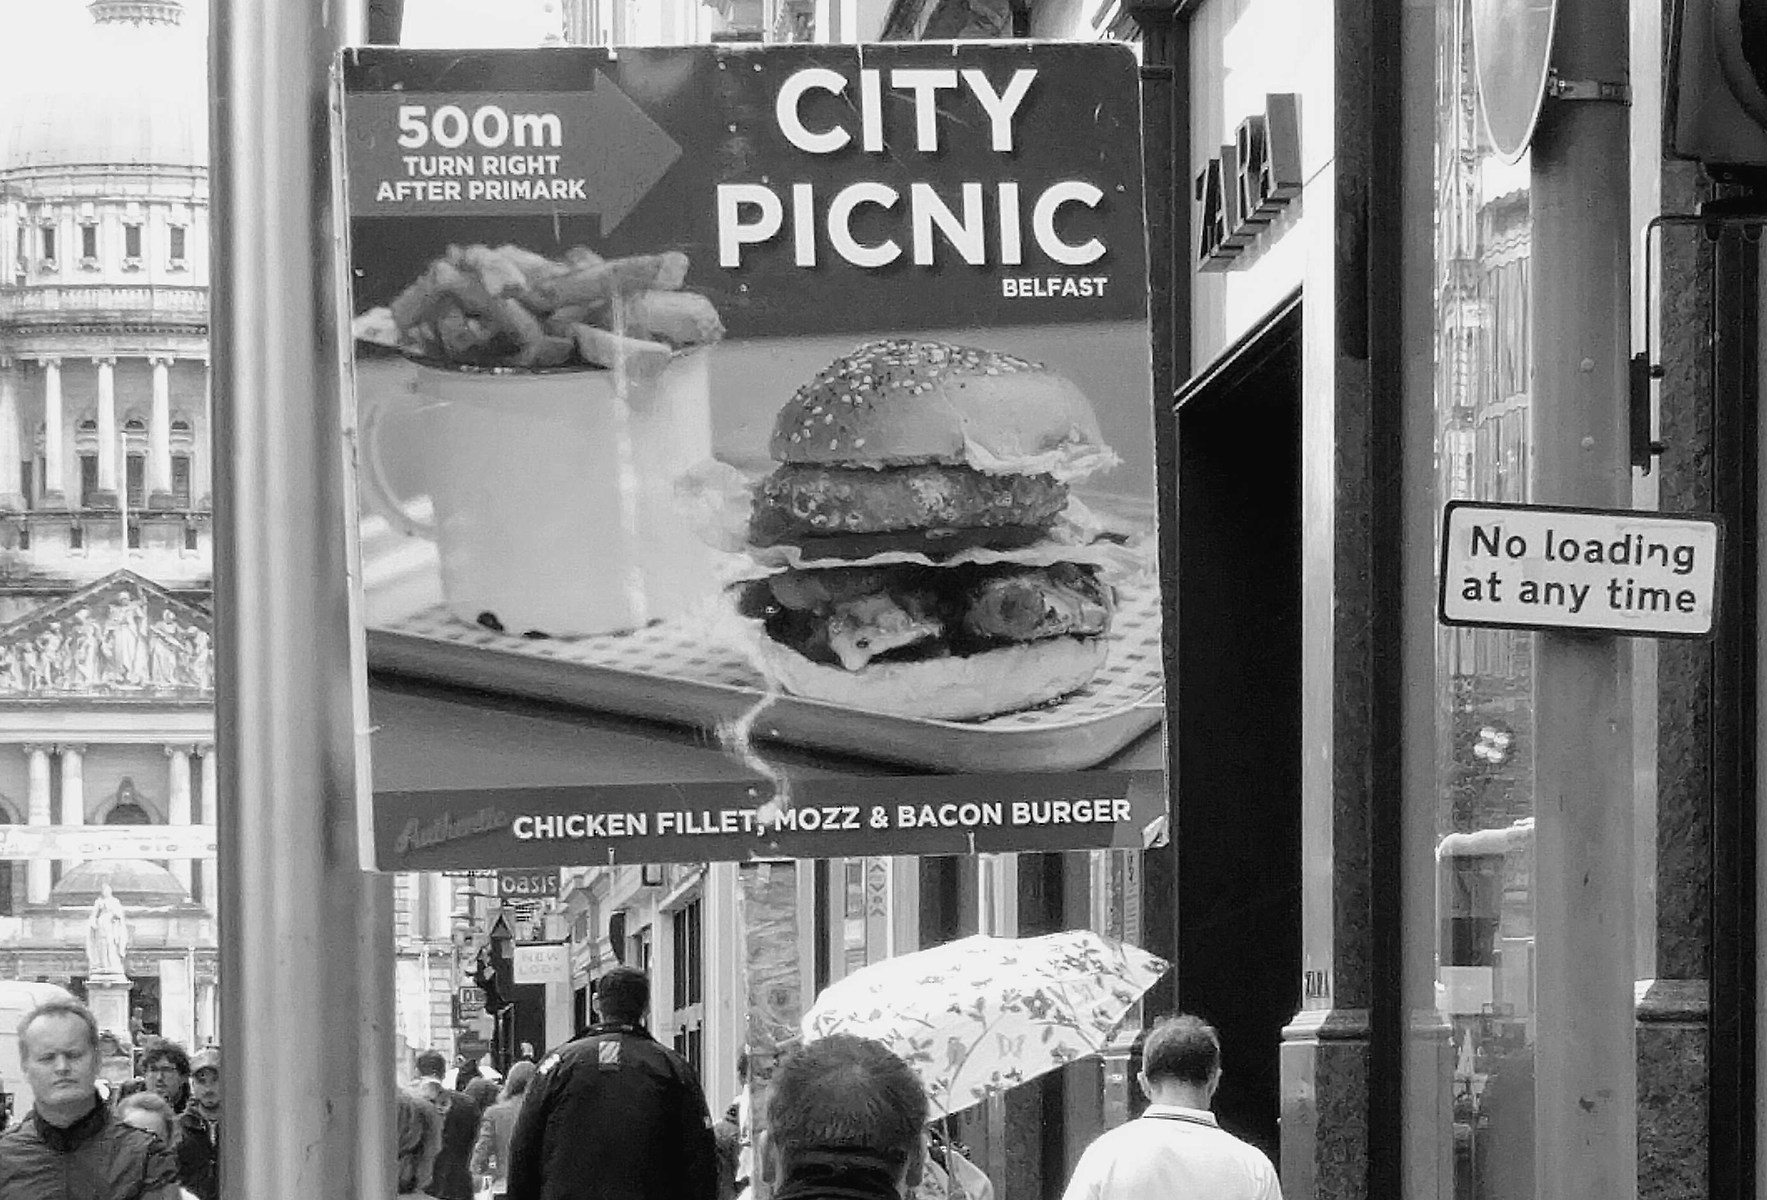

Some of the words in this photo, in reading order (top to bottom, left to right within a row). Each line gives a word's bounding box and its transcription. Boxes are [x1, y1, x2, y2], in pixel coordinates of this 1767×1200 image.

[397, 105, 563, 149] 500m
[776, 68, 1039, 154] CITY
[403, 155, 474, 177] TURN
[481, 155, 561, 176] RIGHT
[376, 180, 462, 201] AFTER
[468, 178, 587, 200] PRIMARK
[716, 180, 1108, 268] PICNIC
[1002, 277, 1108, 297] BELFAST
[1470, 525, 1527, 559] No
[1544, 529, 1696, 575] loading
[1461, 571, 1502, 602] at
[1518, 579, 1590, 613] any
[1606, 577, 1696, 613] time
[512, 812, 648, 840] CHICKEN
[656, 809, 765, 837] FILLET,
[774, 807, 861, 831] MOZZ
[869, 806, 890, 829] &
[897, 802, 1002, 828] BACON
[1011, 799, 1132, 825] BURGER
